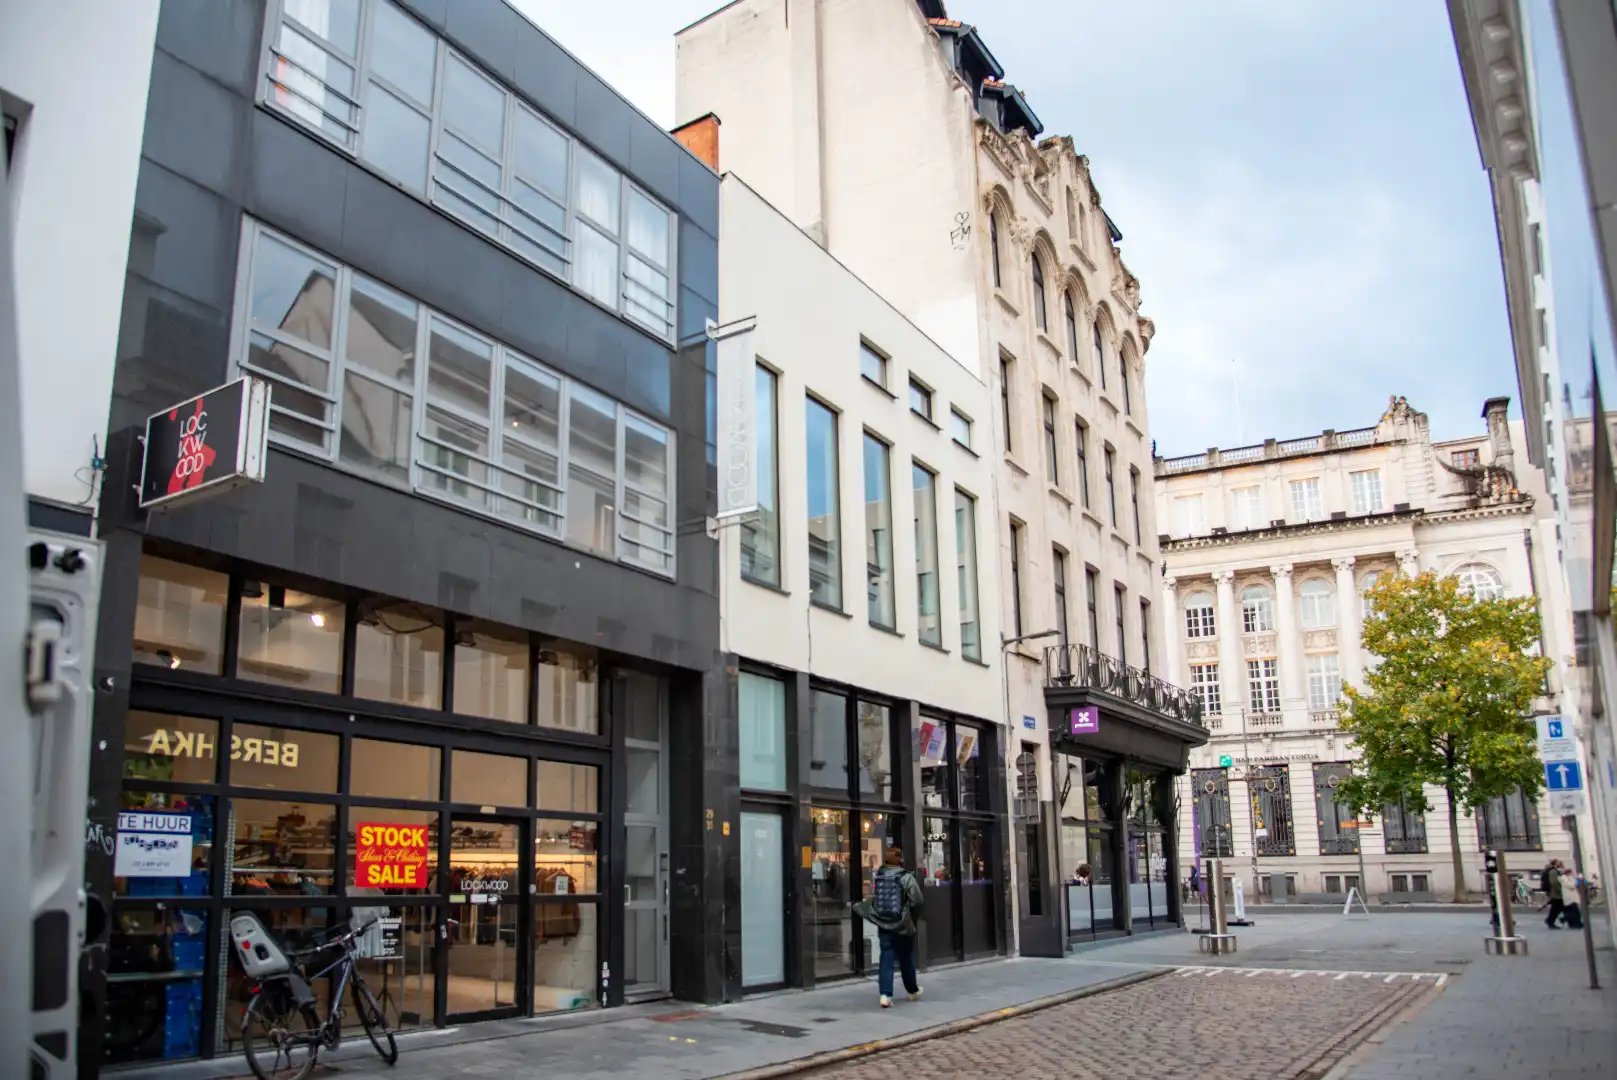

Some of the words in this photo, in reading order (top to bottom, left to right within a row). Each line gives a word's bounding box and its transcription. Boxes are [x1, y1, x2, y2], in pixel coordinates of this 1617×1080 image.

[180, 411, 208, 438] LOC
[177, 431, 207, 459] KW
[175, 453, 205, 478] OOD
[119, 815, 137, 828] TE
[143, 815, 189, 831] HUUR
[360, 825, 425, 847] STOCK
[367, 863, 417, 885] SALE
[460, 879, 509, 891] LOCKWOOD
